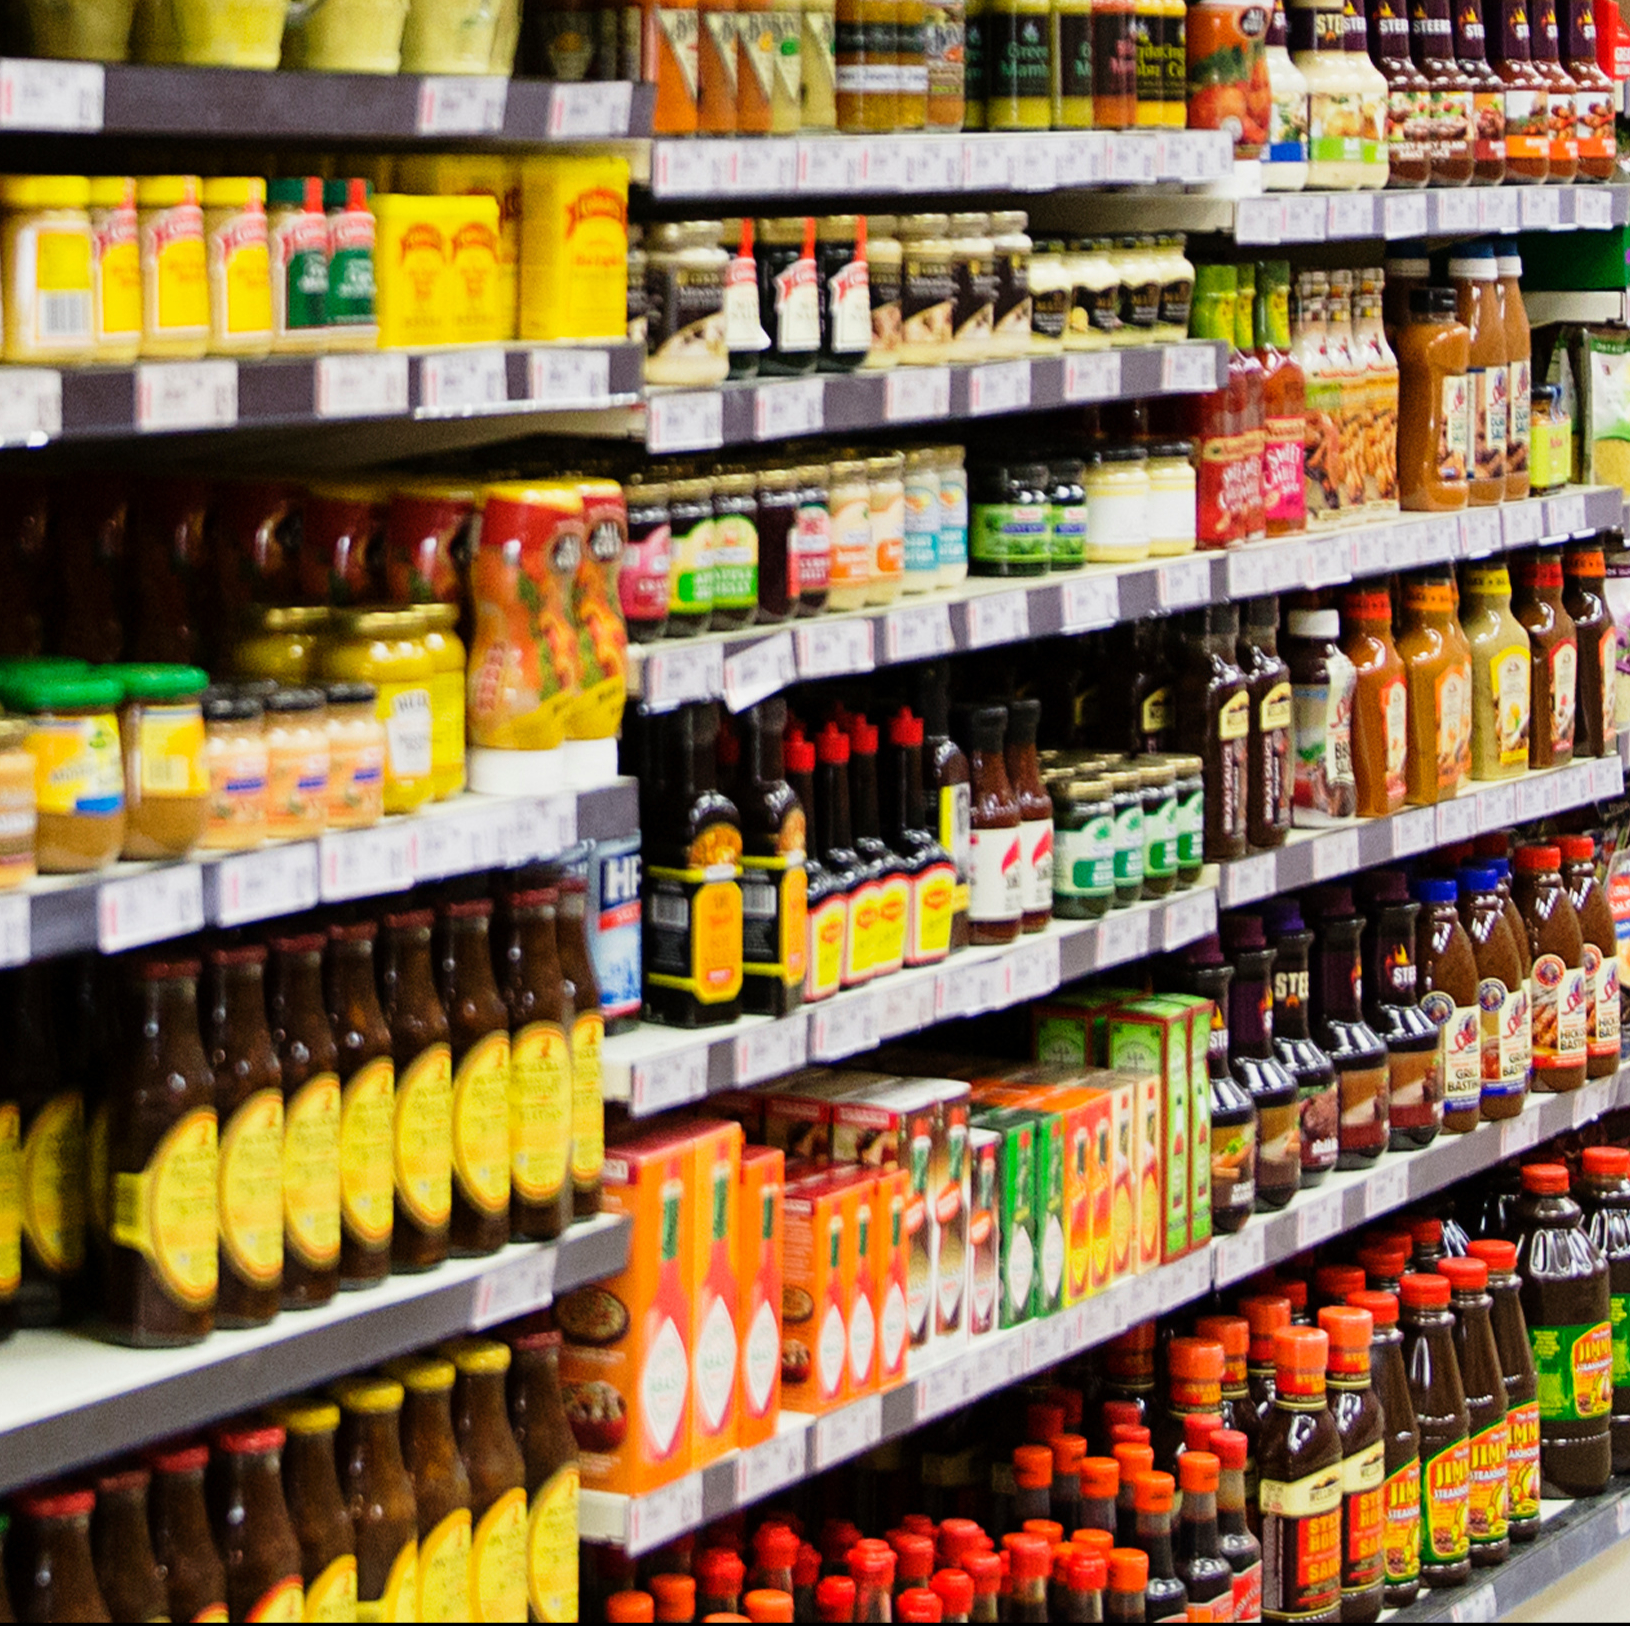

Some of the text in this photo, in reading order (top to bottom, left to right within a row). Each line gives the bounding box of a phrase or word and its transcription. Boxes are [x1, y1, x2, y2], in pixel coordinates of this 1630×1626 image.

[1001, 58, 1048, 76] Mamb
[1275, 971, 1309, 1001] STE
[1560, 1039, 1586, 1051] BASTIN
